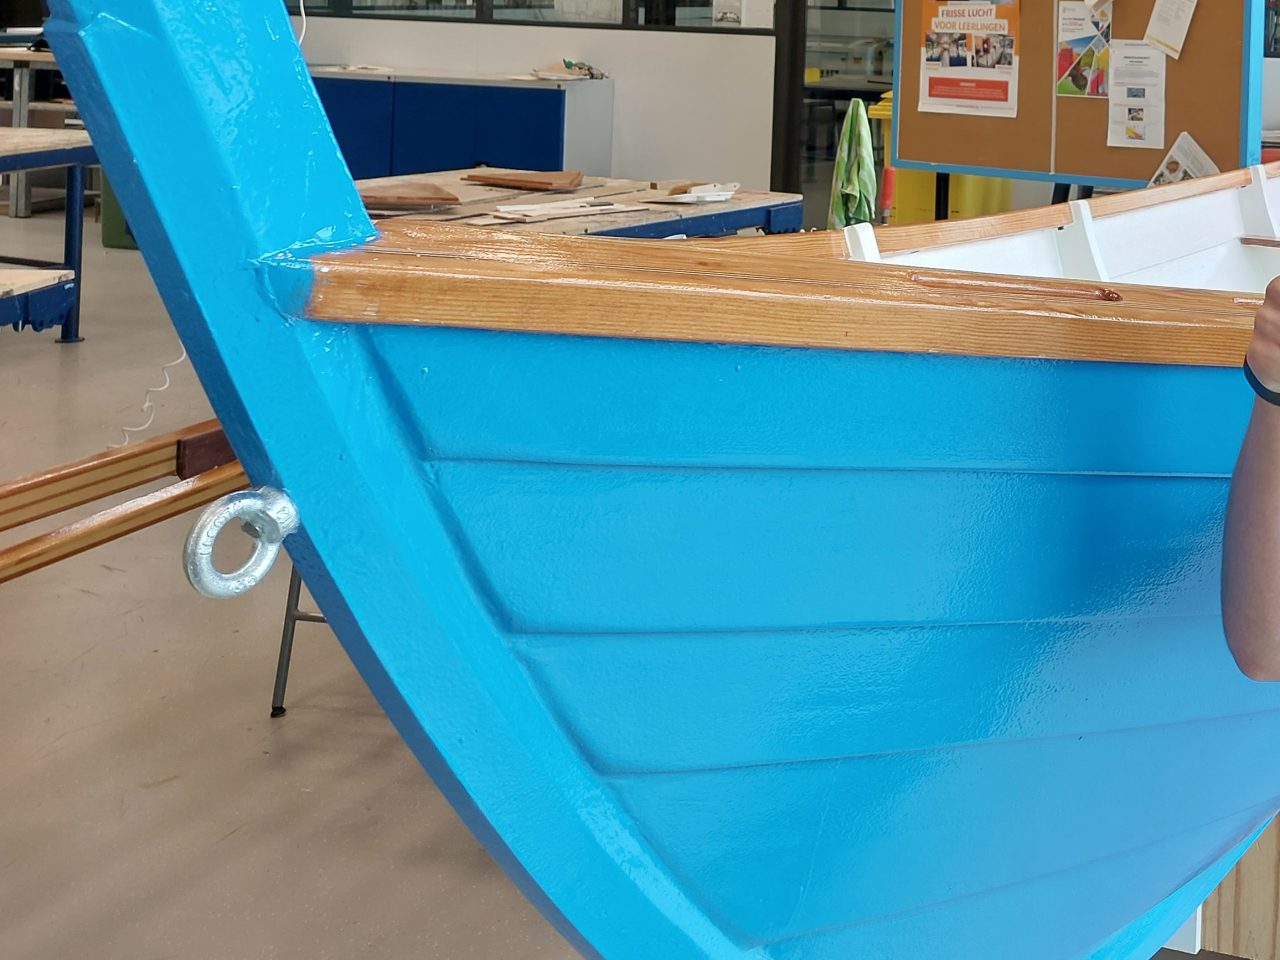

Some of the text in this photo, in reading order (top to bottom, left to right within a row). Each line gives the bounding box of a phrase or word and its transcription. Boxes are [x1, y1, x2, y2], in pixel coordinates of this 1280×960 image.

[941, 8, 993, 18] FRISSE LUCHT
[934, 20, 1006, 32] VOOR LEERLINGEN
